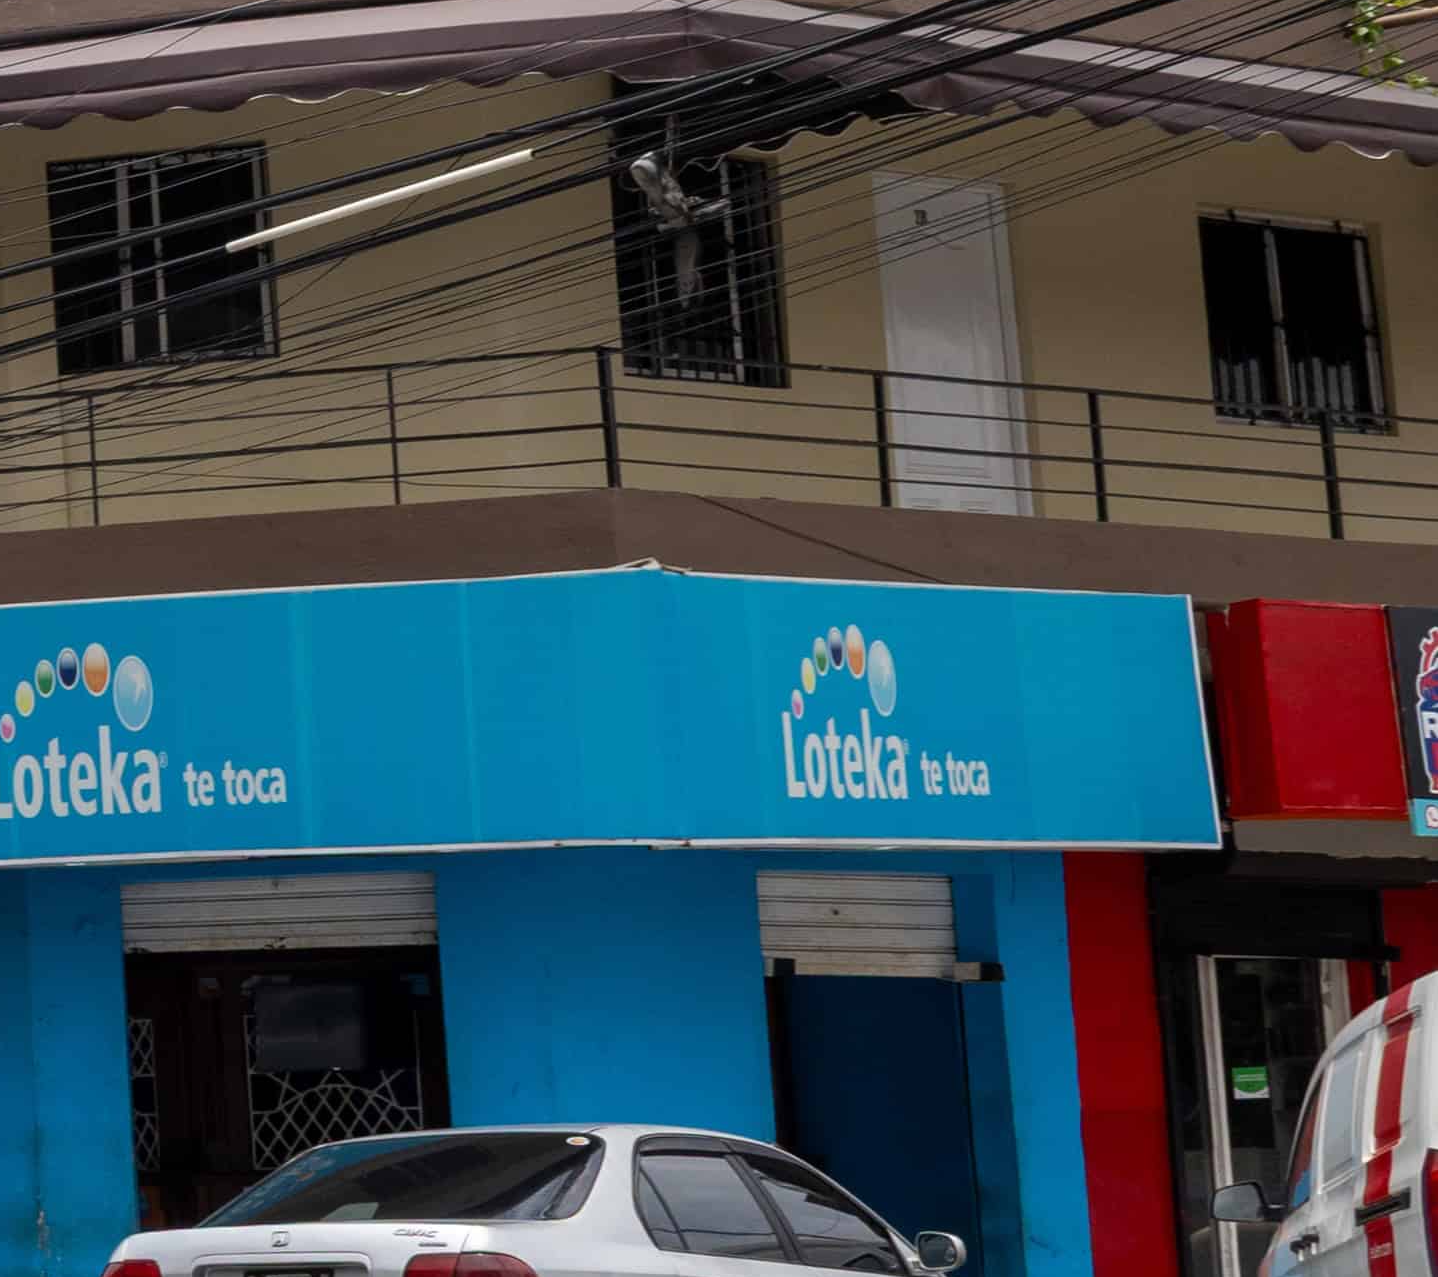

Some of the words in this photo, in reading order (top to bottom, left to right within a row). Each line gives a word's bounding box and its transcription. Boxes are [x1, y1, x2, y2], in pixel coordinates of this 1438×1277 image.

[183, 762, 215, 807] te
[222, 760, 287, 805] toca
[782, 708, 909, 799] Loteka
[919, 751, 943, 796] te
[945, 750, 991, 796] toca
